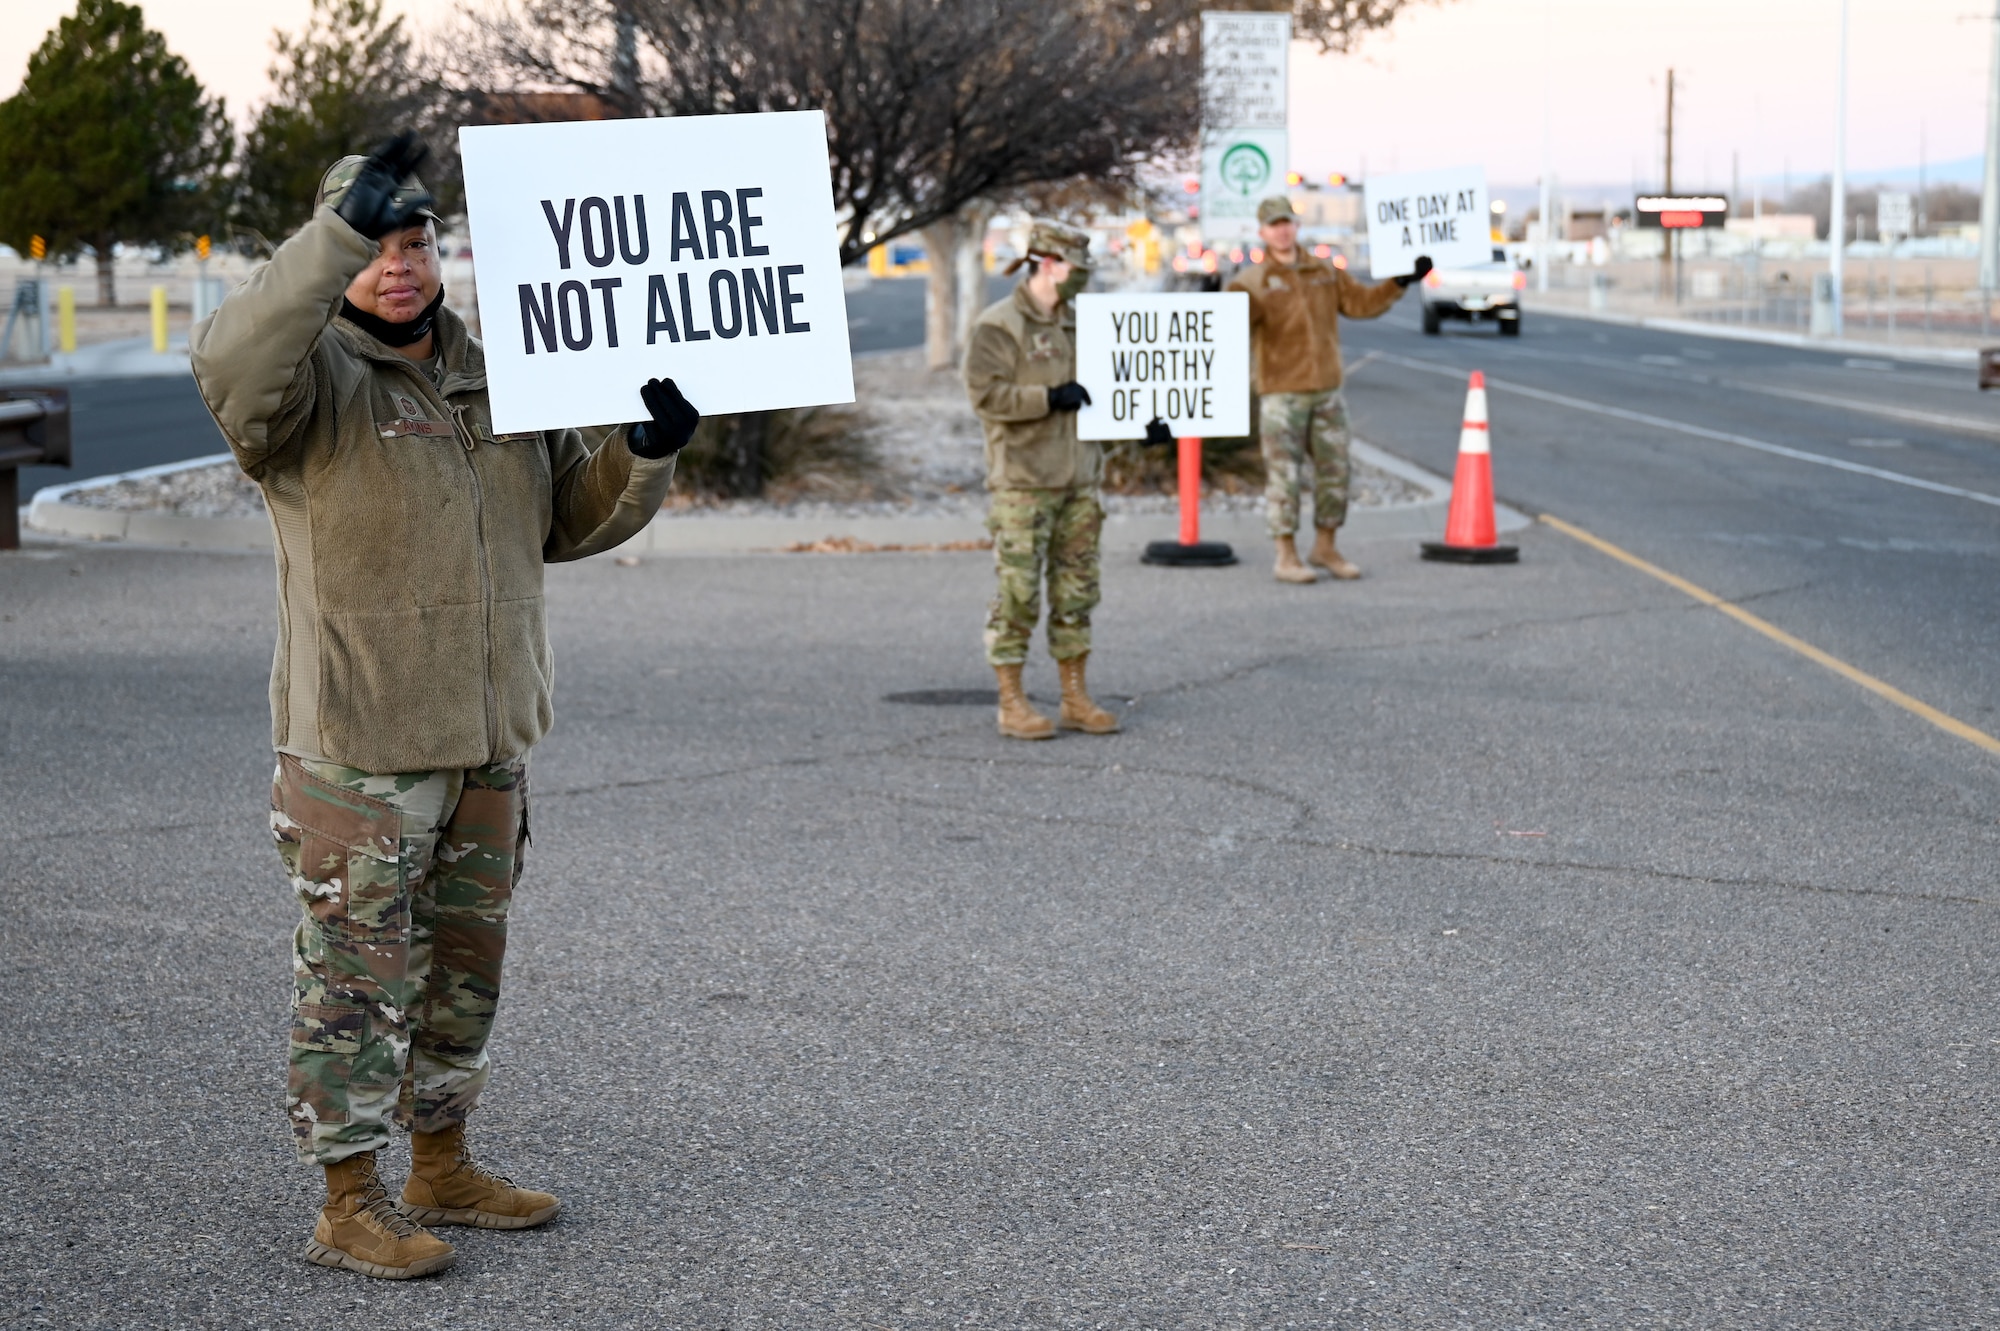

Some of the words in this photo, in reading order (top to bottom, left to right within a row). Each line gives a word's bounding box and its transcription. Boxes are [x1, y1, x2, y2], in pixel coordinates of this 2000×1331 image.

[1377, 197, 1411, 224] ONE
[1417, 193, 1449, 219] DAY
[1456, 189, 1475, 213] AT
[540, 194, 650, 270] YOU
[670, 187, 770, 262] ARE
[1401, 226, 1412, 247] A
[1418, 219, 1458, 246] TIME
[518, 277, 622, 355] NOT
[646, 264, 811, 345] ALONE
[1111, 311, 1159, 344] YOU
[1168, 310, 1214, 343] ARE
[1111, 349, 1215, 383] WORTHY
[1112, 388, 1141, 421] OF
[1152, 387, 1214, 420] LOVE
[403, 419, 433, 434] AKINS
